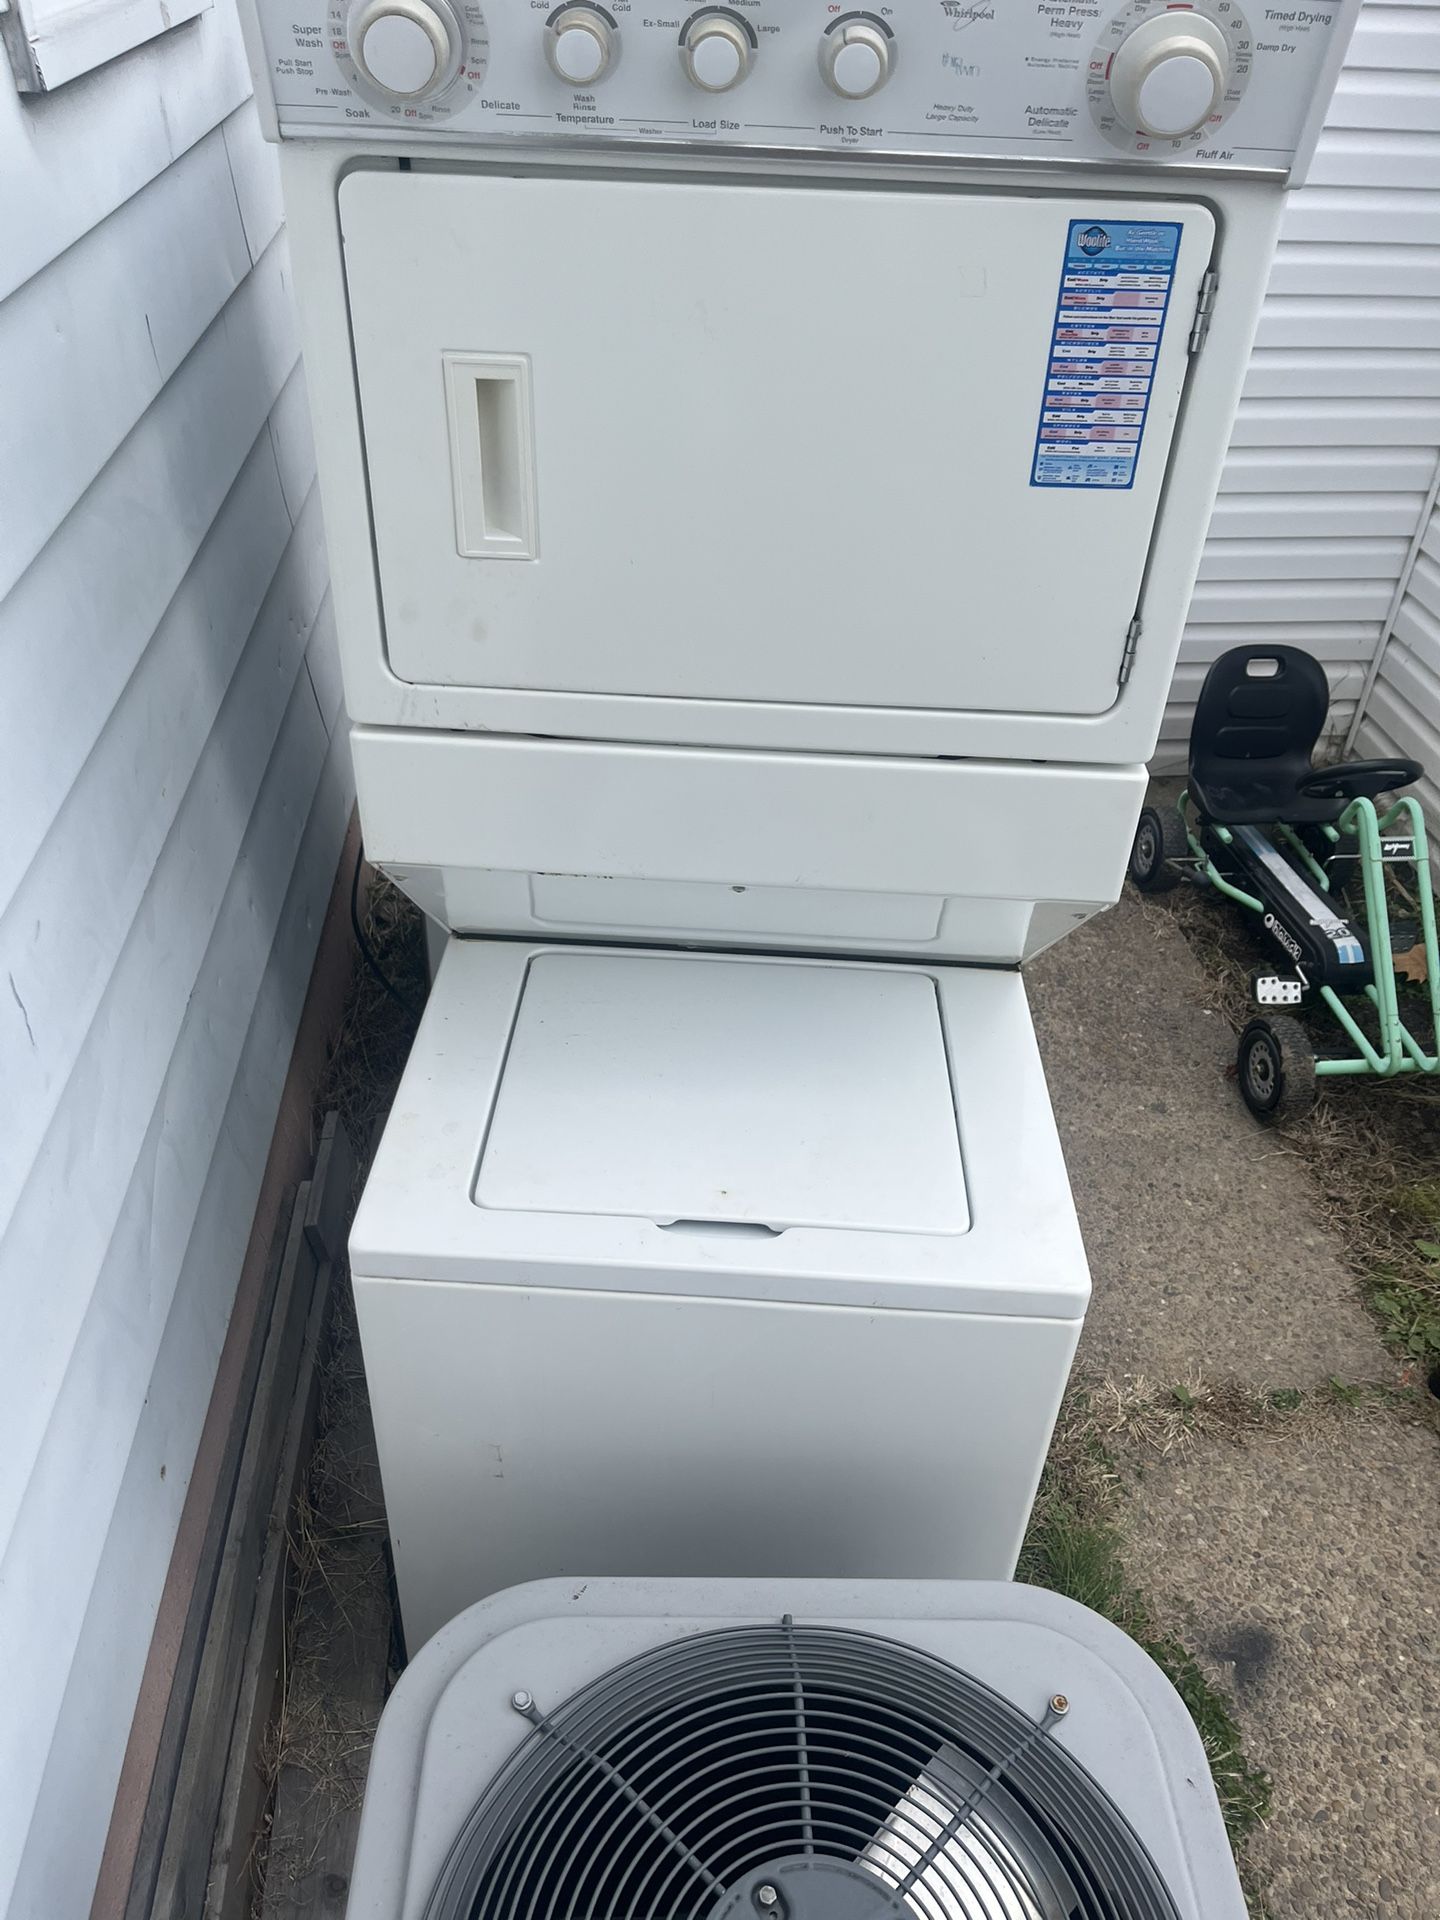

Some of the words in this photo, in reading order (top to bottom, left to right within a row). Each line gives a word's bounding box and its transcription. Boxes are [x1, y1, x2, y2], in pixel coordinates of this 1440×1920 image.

[531, 1, 550, 9] Cold
[612, 4, 632, 12] Cold
[828, 4, 841, 13] Off
[1219, 3, 1230, 12] 50
[331, 11, 342, 19] 14
[881, 7, 893, 16] On
[944, 7, 994, 21] Whirlpool
[1037, 4, 1066, 15] Perm
[1069, 6, 1099, 17] Press
[1264, 9, 1297, 21] Timed
[1297, 12, 1332, 26] Drying
[643, 19, 680, 28] Ex-Small
[1050, 18, 1083, 30] Heavy
[1231, 20, 1242, 29] 40
[292, 24, 322, 35] Super
[332, 27, 342, 35] 18
[757, 25, 780, 34] Large
[295, 38, 323, 48] Wash
[332, 41, 346, 49] Off
[1237, 40, 1249, 50] 30
[1256, 42, 1280, 52] Damp
[1281, 44, 1297, 53] Dry
[294, 59, 312, 68] Start
[1089, 61, 1103, 70] Off
[276, 67, 295, 75] Push
[296, 68, 314, 76] Stop
[1236, 65, 1248, 74] 20
[467, 71, 480, 80] Off
[573, 94, 596, 103] Wash
[481, 99, 521, 111] Delicate
[572, 102, 596, 111] Rinse
[345, 108, 371, 118] Soak
[404, 108, 417, 117] Off
[1024, 105, 1079, 117] Automatic
[556, 112, 615, 125] Temperature
[1027, 117, 1070, 128] Delicate
[692, 118, 717, 129] Load
[719, 120, 741, 130] Size
[819, 124, 845, 135] Push
[846, 125, 858, 135] To
[859, 126, 883, 137] Start
[1189, 132, 1202, 140] 20
[1136, 142, 1150, 150] Off
[1171, 141, 1181, 149] 10
[1195, 149, 1218, 159] Fluff
[1219, 151, 1235, 160] Air
[1077, 233, 1111, 248] Woolite
